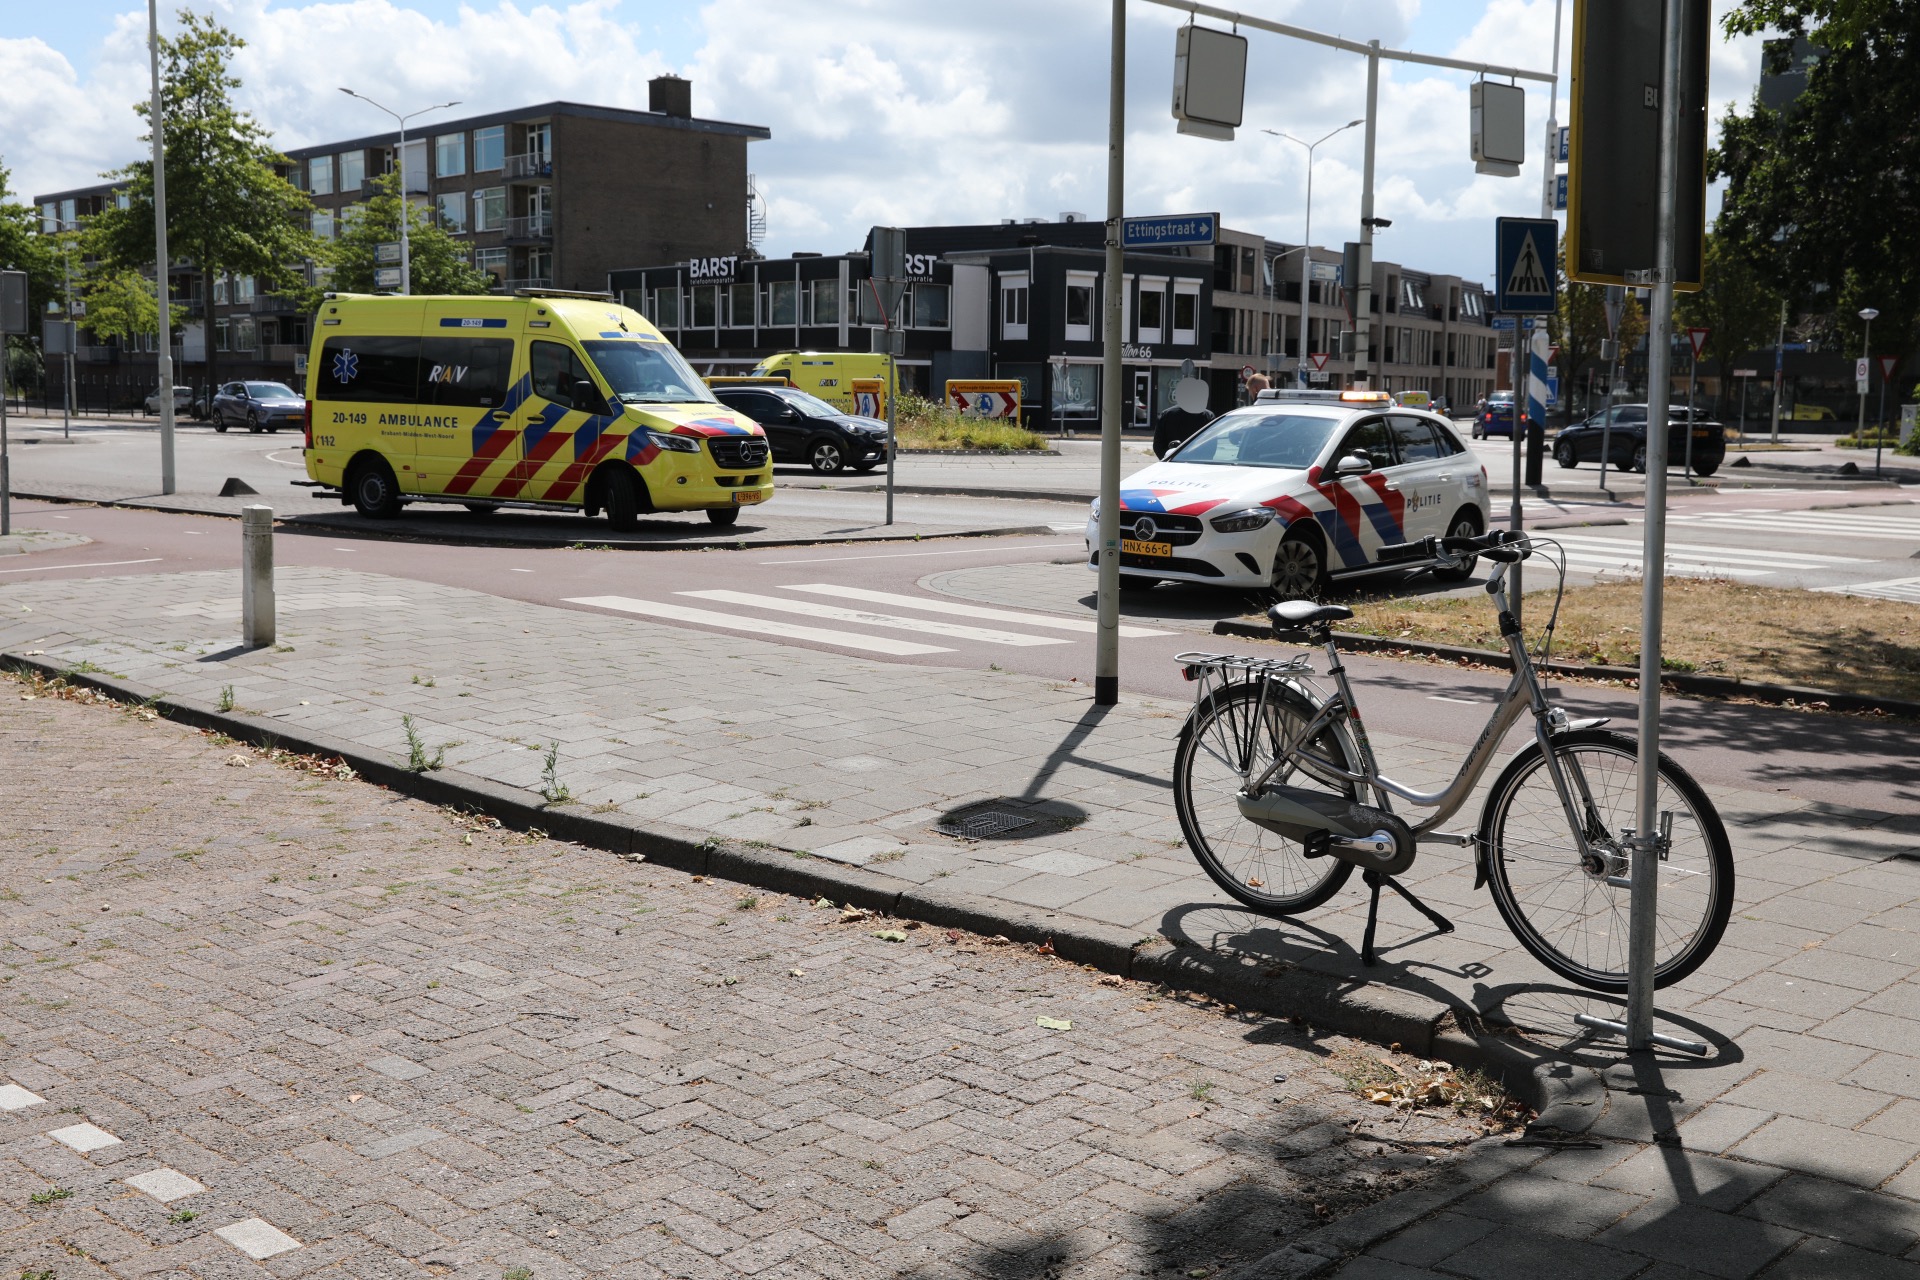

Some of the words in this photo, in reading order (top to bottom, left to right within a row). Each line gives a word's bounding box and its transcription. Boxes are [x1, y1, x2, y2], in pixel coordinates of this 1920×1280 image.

[1128, 221, 1196, 240] Ettingstraat
[690, 256, 738, 278] BARST
[905, 253, 937, 275] RST
[1139, 346, 1152, 358] 66
[332, 412, 367, 425] 20-149
[379, 413, 459, 429] AMBULANCE
[1147, 480, 1210, 489] POLITIE
[1406, 492, 1442, 512] POLITIE
[1123, 540, 1168, 555] HNX-66-G
